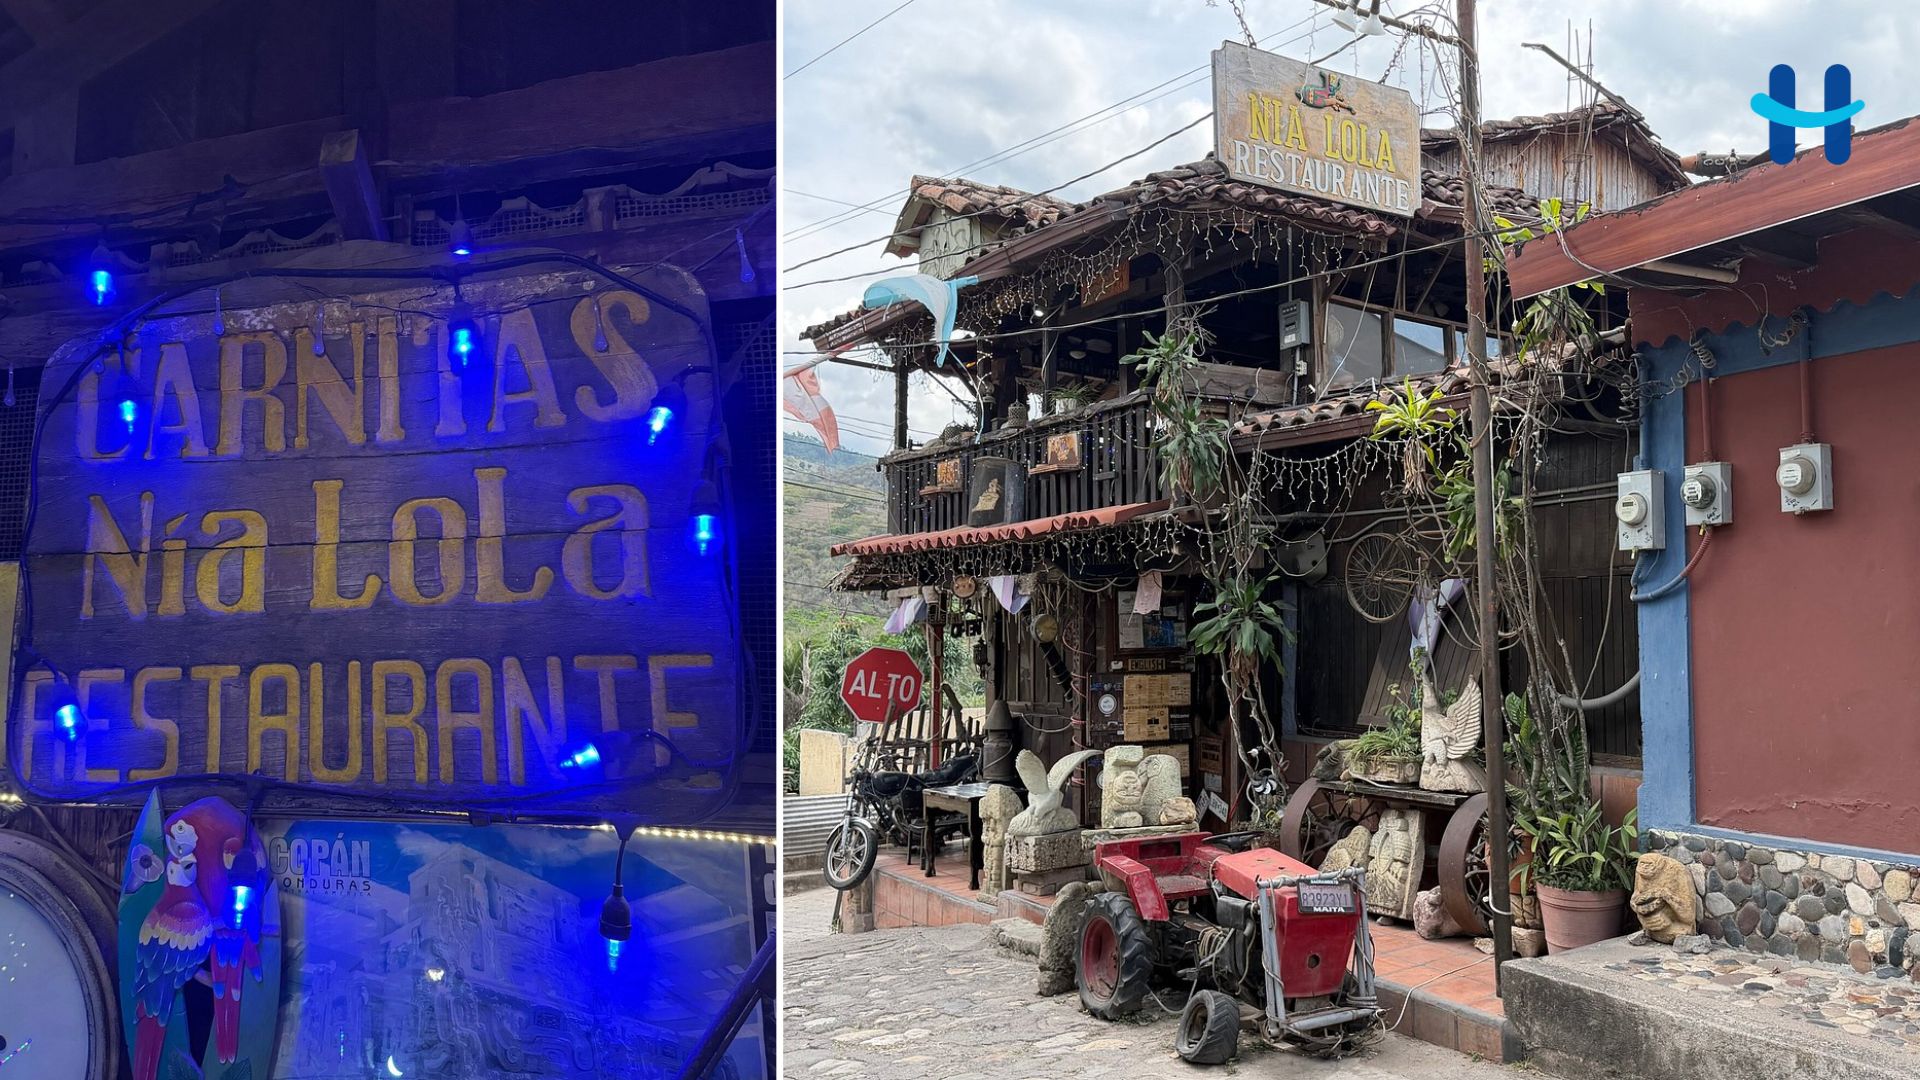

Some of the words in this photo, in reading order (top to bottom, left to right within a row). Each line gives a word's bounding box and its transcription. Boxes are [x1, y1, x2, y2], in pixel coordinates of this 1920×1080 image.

[1248, 94, 1308, 152] NIA
[1324, 114, 1397, 173] LOLA
[1233, 140, 1410, 211] RESTAURANTE
[76, 289, 659, 461] CARNITAS
[848, 669, 915, 703] ALTO
[1130, 659, 1164, 670] ENGLISH
[20, 653, 724, 791] RESTAURANTE
[268, 832, 371, 878] COPÁN
[282, 877, 371, 891] ONDURAS
